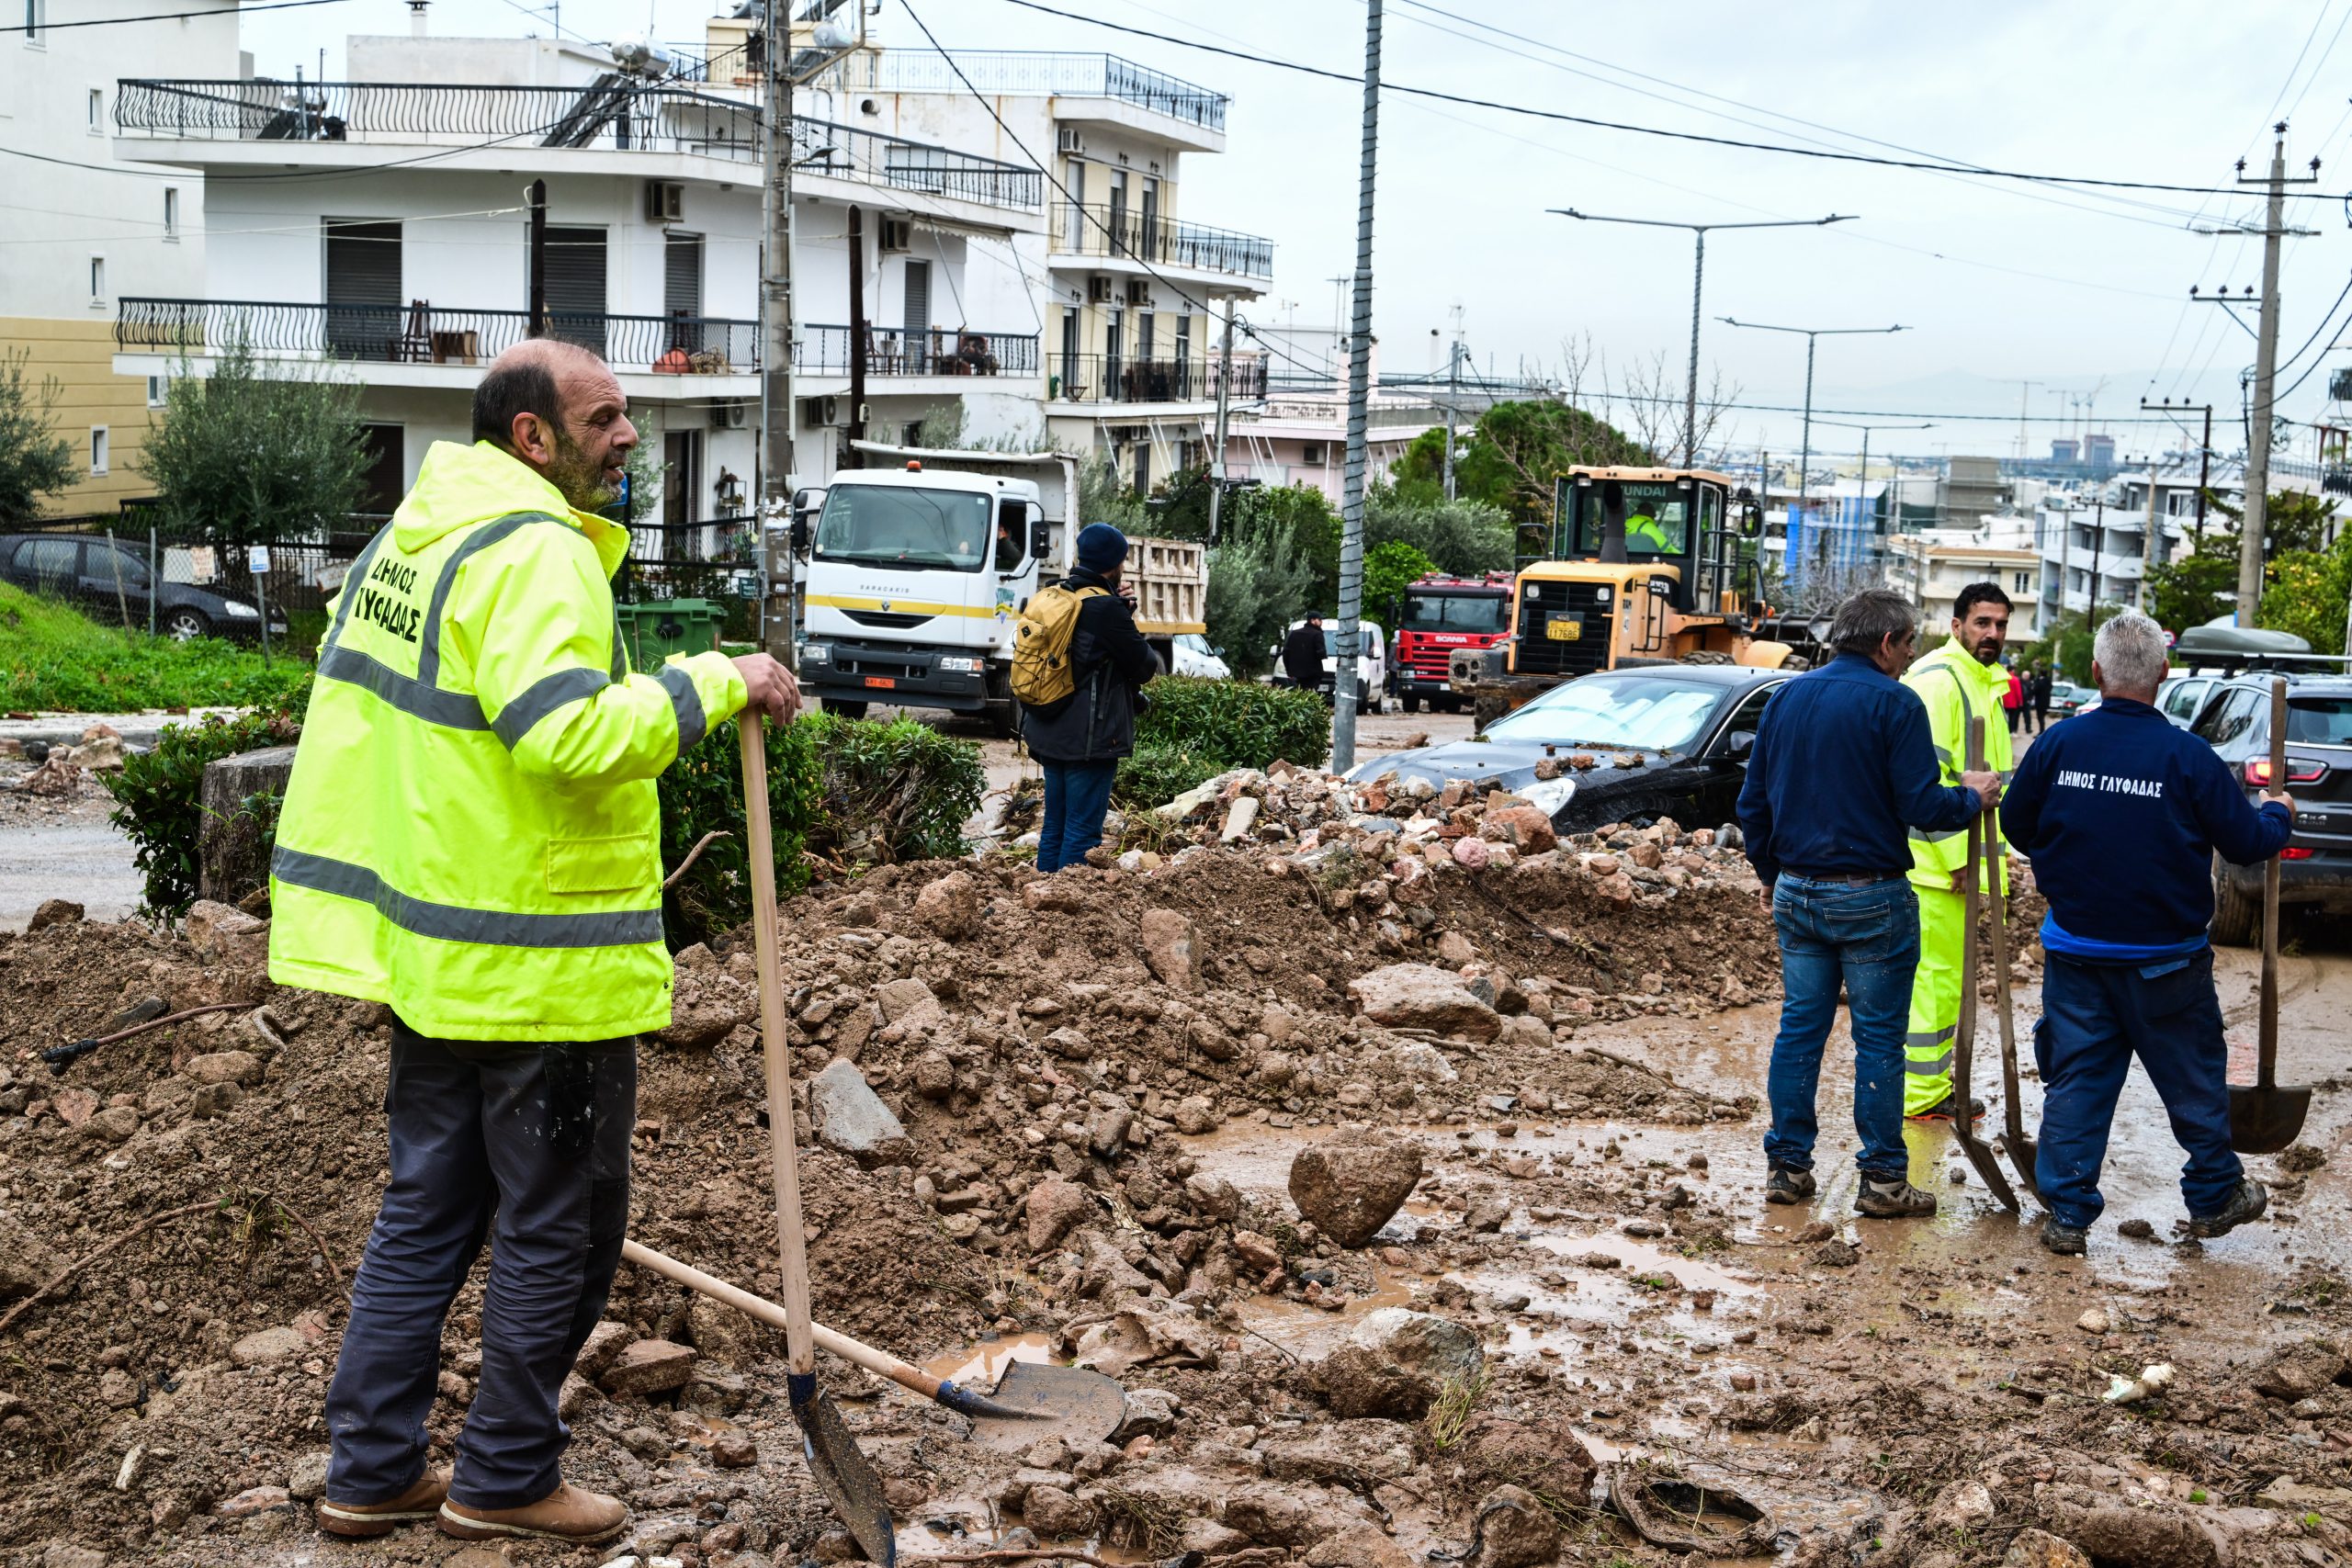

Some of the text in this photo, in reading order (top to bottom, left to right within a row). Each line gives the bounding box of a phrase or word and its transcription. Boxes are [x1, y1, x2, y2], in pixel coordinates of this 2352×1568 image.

[1621, 485, 1667, 497] UNDAI
[2057, 770, 2163, 798] ΔΗΜΟΣ ΓΛΥΦΑΔΑΣ
